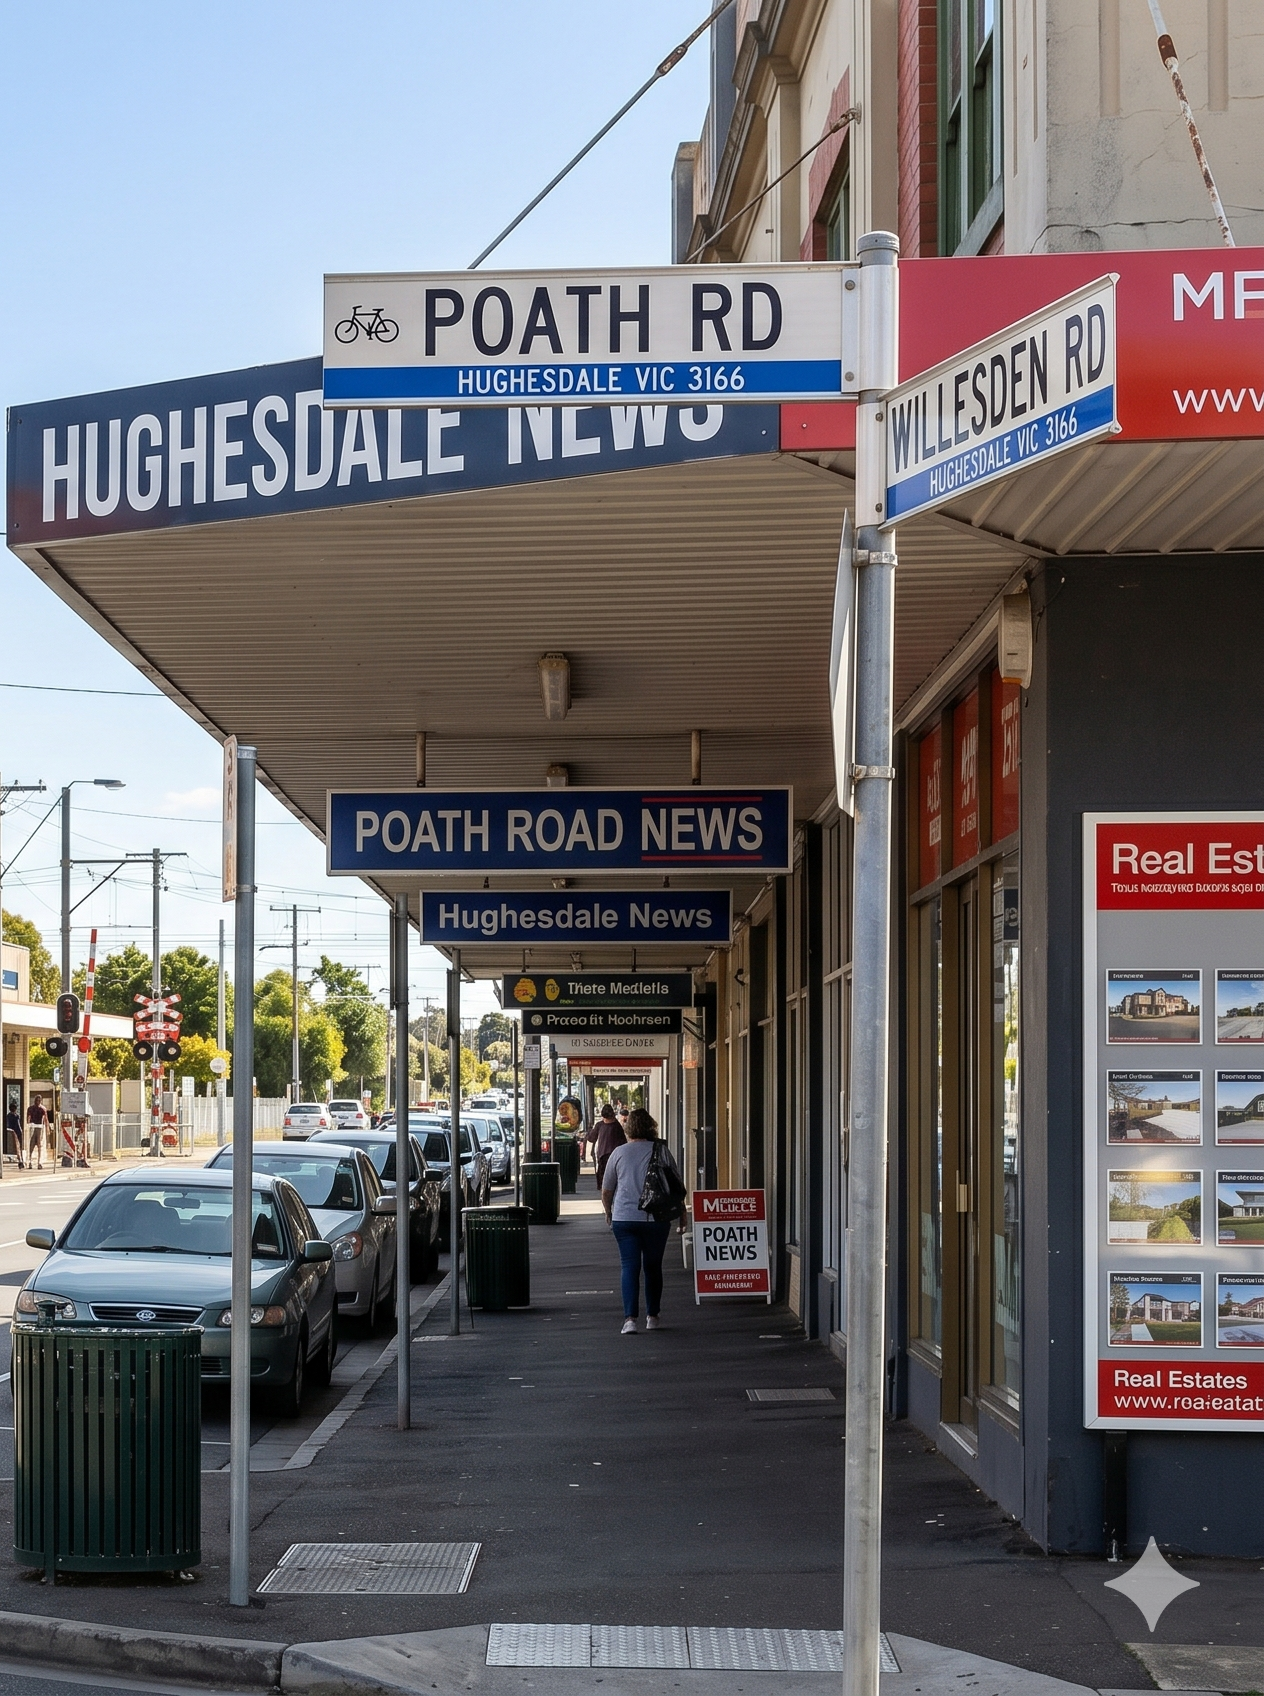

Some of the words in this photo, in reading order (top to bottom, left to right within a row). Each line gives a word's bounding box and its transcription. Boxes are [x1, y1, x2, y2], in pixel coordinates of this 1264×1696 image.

[425, 284, 650, 356] POATH
[691, 282, 783, 352] RD
[458, 367, 622, 395] HUGHESDALE
[636, 366, 675, 392] VIC
[688, 365, 745, 390] 3166
[891, 329, 1048, 474] WILLESDEN
[1065, 303, 1106, 394] RD
[42, 389, 464, 523] HUGHESDALE
[929, 435, 1012, 497] HUGHESDALE
[1017, 423, 1039, 458] VIC
[1045, 406, 1078, 445] 3166
[355, 808, 489, 853] POATH
[507, 807, 624, 852] ROAD
[641, 806, 763, 852] NEWS
[1112, 843, 1194, 875] Real
[439, 902, 618, 936] Hughesdale
[629, 902, 713, 929] News
[702, 1226, 758, 1242] POATH
[705, 1245, 758, 1261] NEWS
[1114, 1369, 1161, 1388] Real
[1169, 1370, 1248, 1389] Estates
